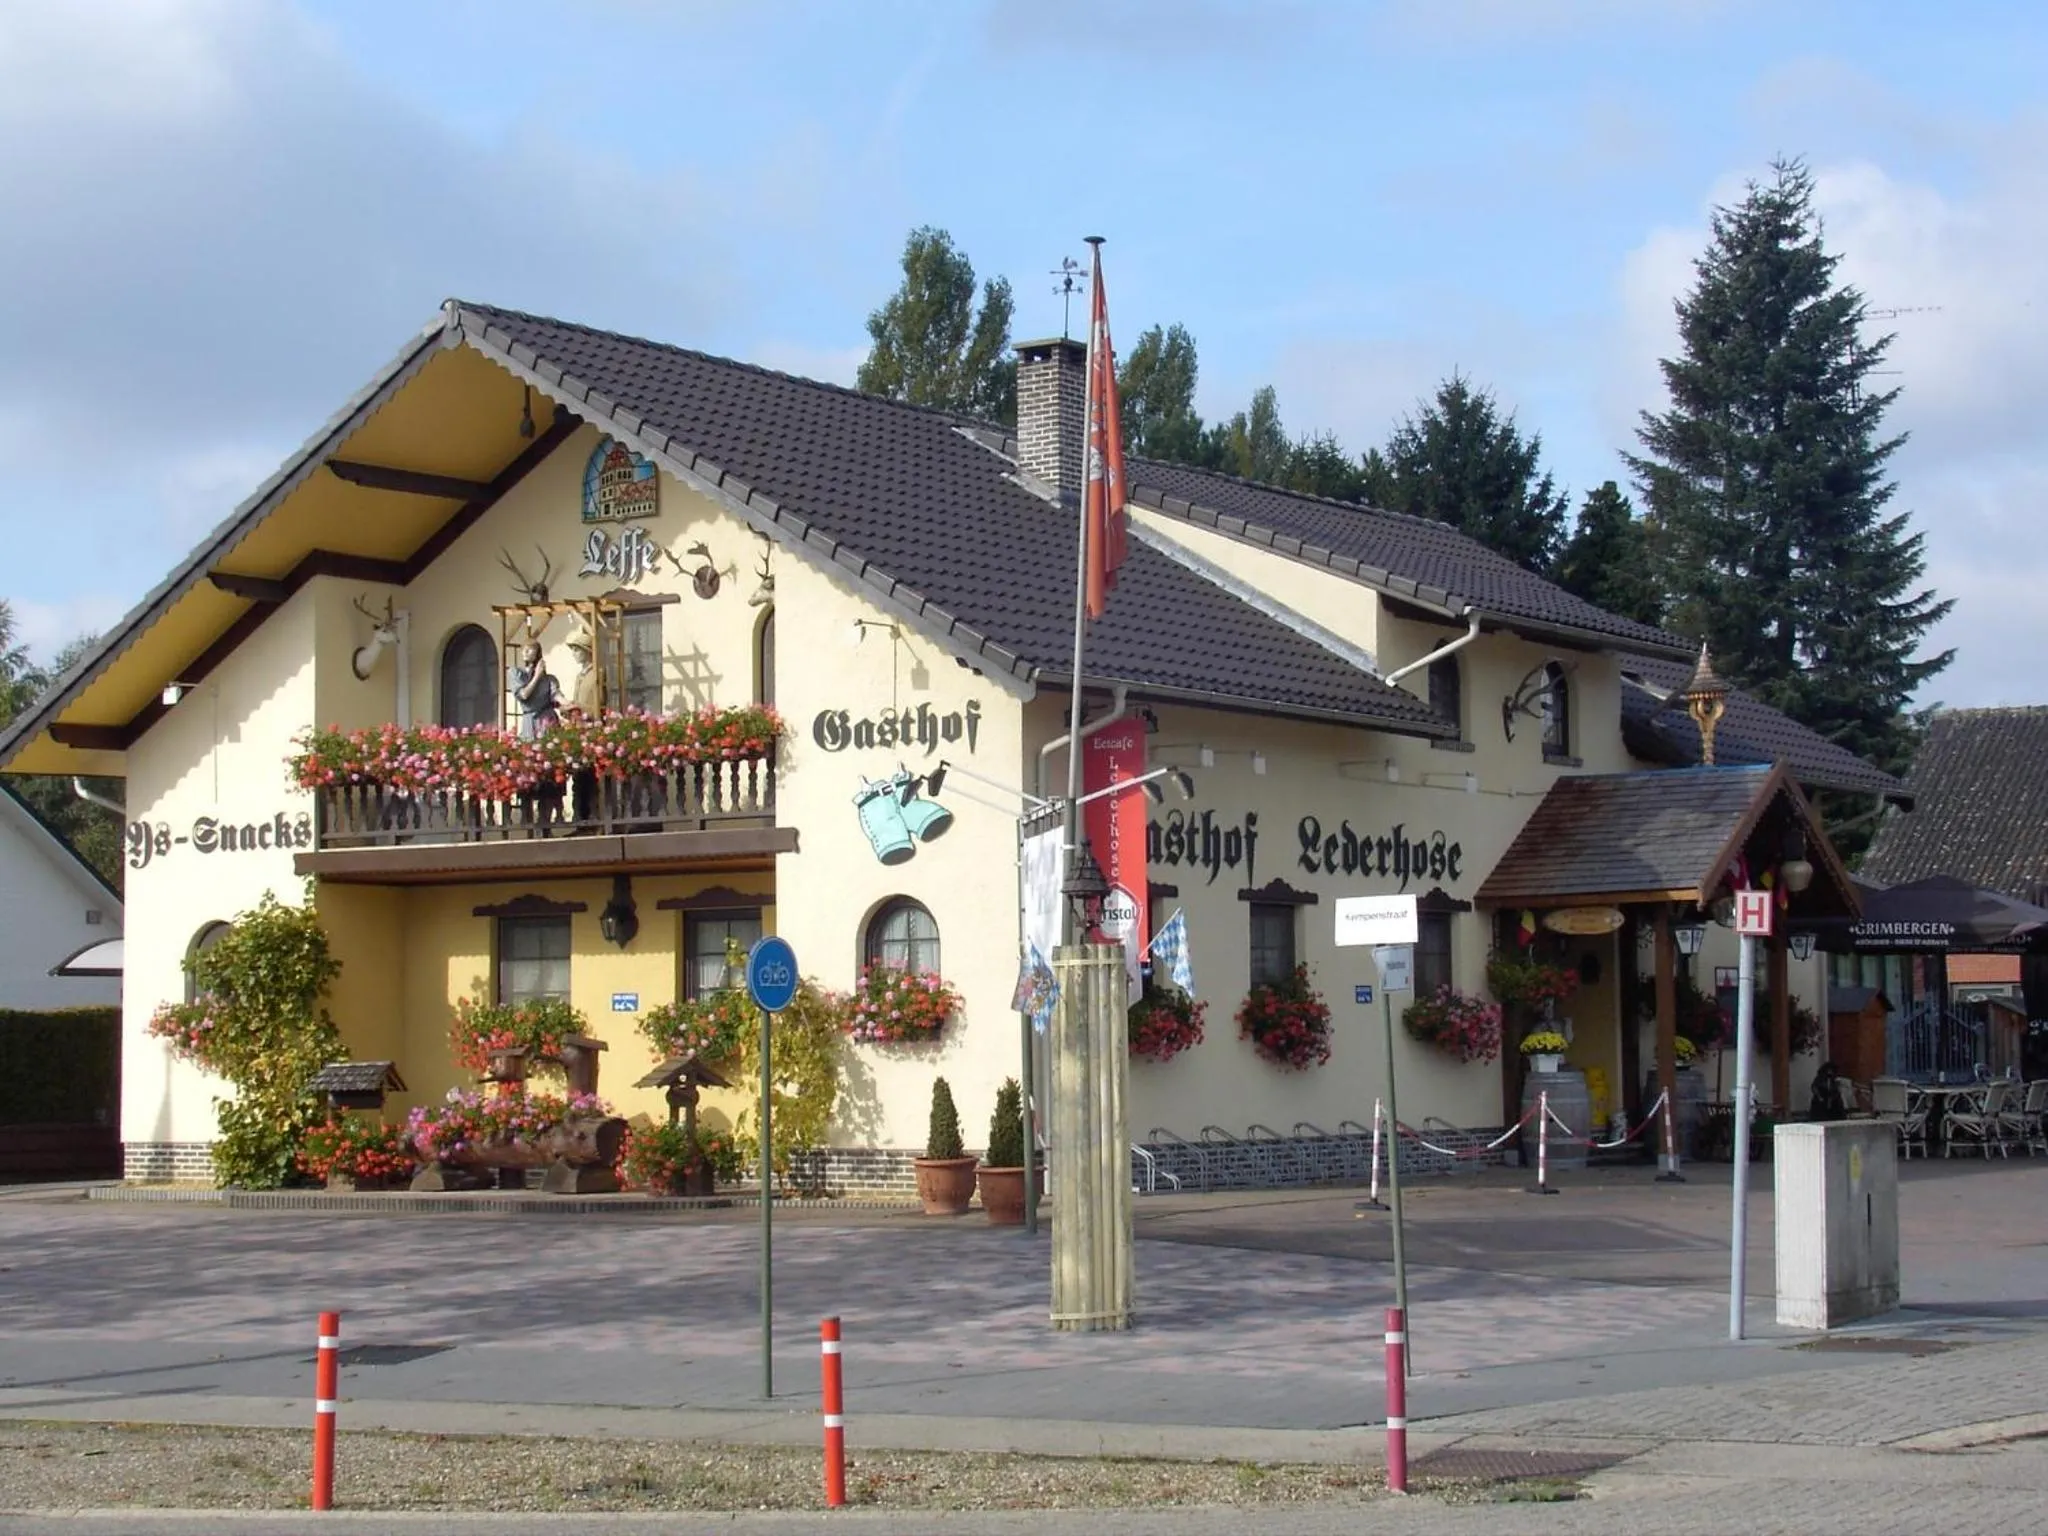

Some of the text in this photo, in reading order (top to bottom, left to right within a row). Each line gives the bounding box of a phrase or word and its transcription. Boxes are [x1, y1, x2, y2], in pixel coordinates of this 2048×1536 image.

[579, 526, 656, 581] Leffe
[812, 698, 982, 758] Gasthof
[1147, 808, 1463, 895] asthof Lederhose
[1102, 905, 1137, 921] ristal
[1742, 896, 1764, 928] H
[1855, 922, 1949, 936] GRIMBERGEN
